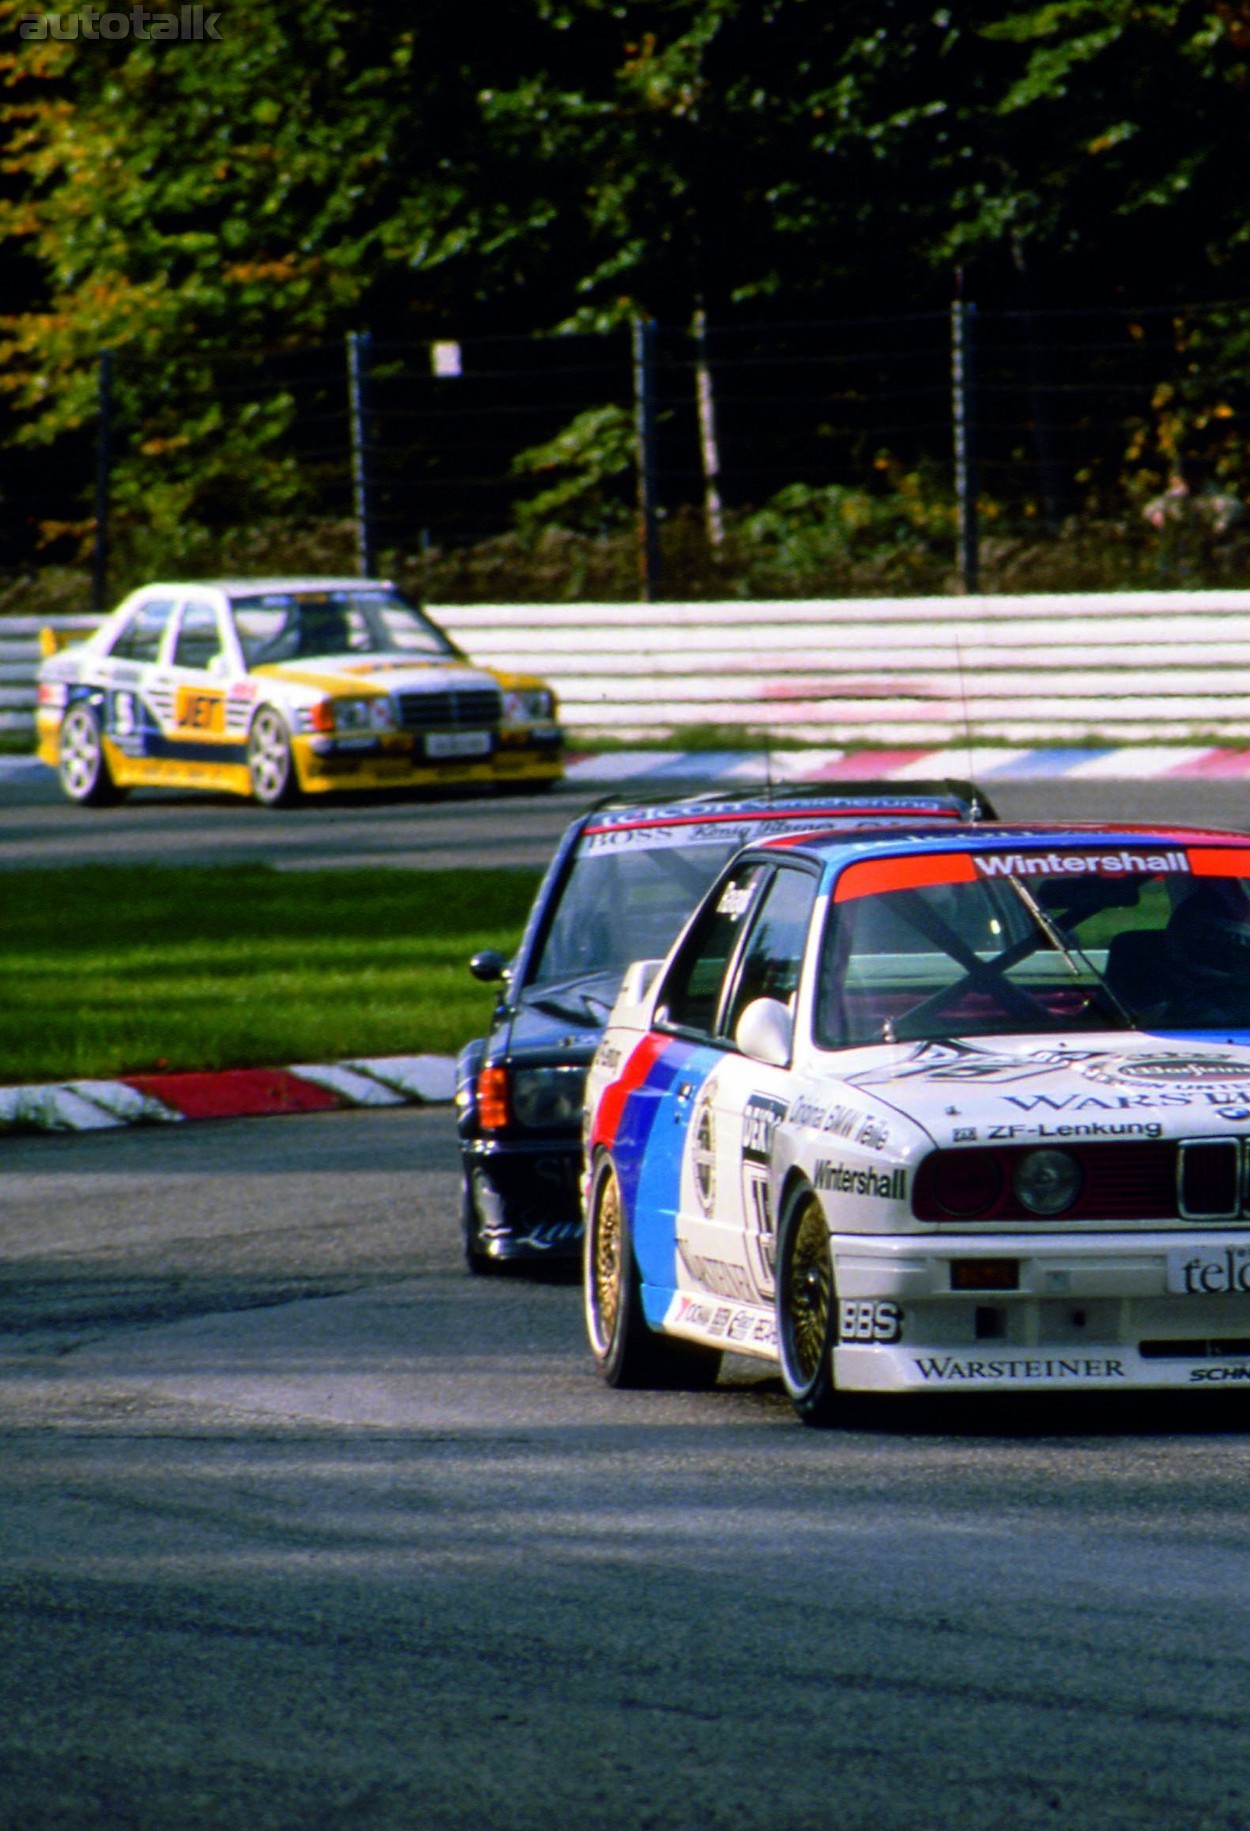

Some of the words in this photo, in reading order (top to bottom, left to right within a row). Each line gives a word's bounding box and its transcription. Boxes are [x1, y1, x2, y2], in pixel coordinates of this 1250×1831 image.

[586, 827, 673, 851] BOSS
[974, 851, 1190, 876] Wintershall
[855, 1114, 890, 1151] Teile
[988, 1121, 1163, 1140] ZF-Lenkung
[814, 1159, 906, 1201] Wintershall
[840, 1300, 903, 1344] BBS
[914, 1356, 1126, 1380] WARSTEINER
